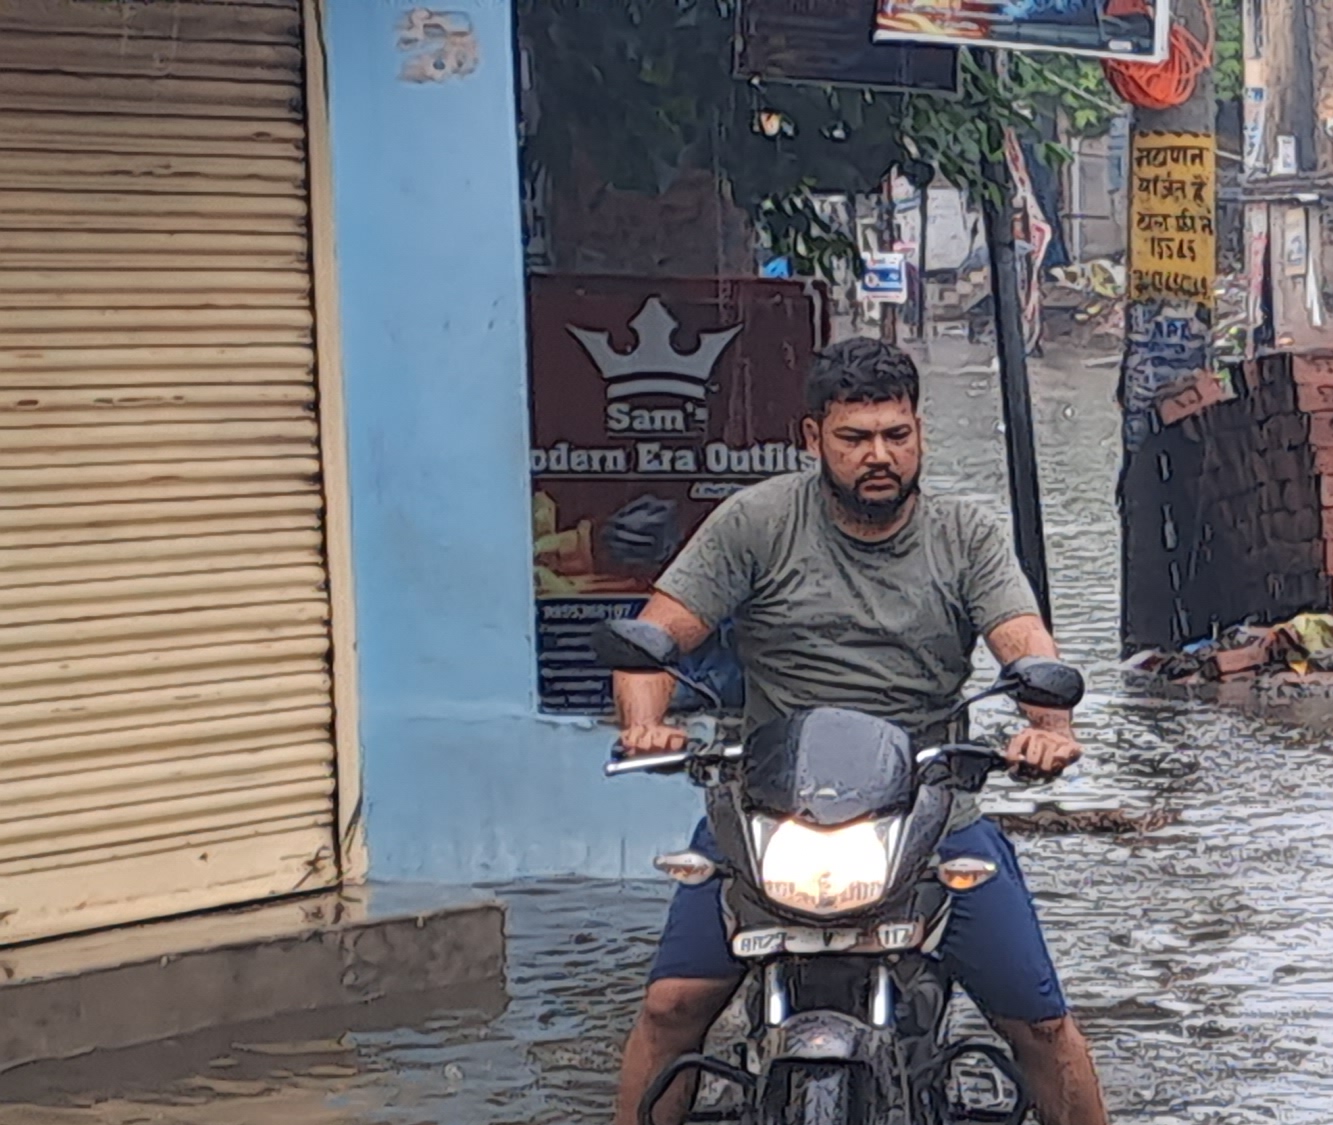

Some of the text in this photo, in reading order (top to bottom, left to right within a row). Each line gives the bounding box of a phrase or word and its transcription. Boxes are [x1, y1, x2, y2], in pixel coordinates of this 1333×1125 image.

[531, 442, 821, 474] odern Era Outfits
